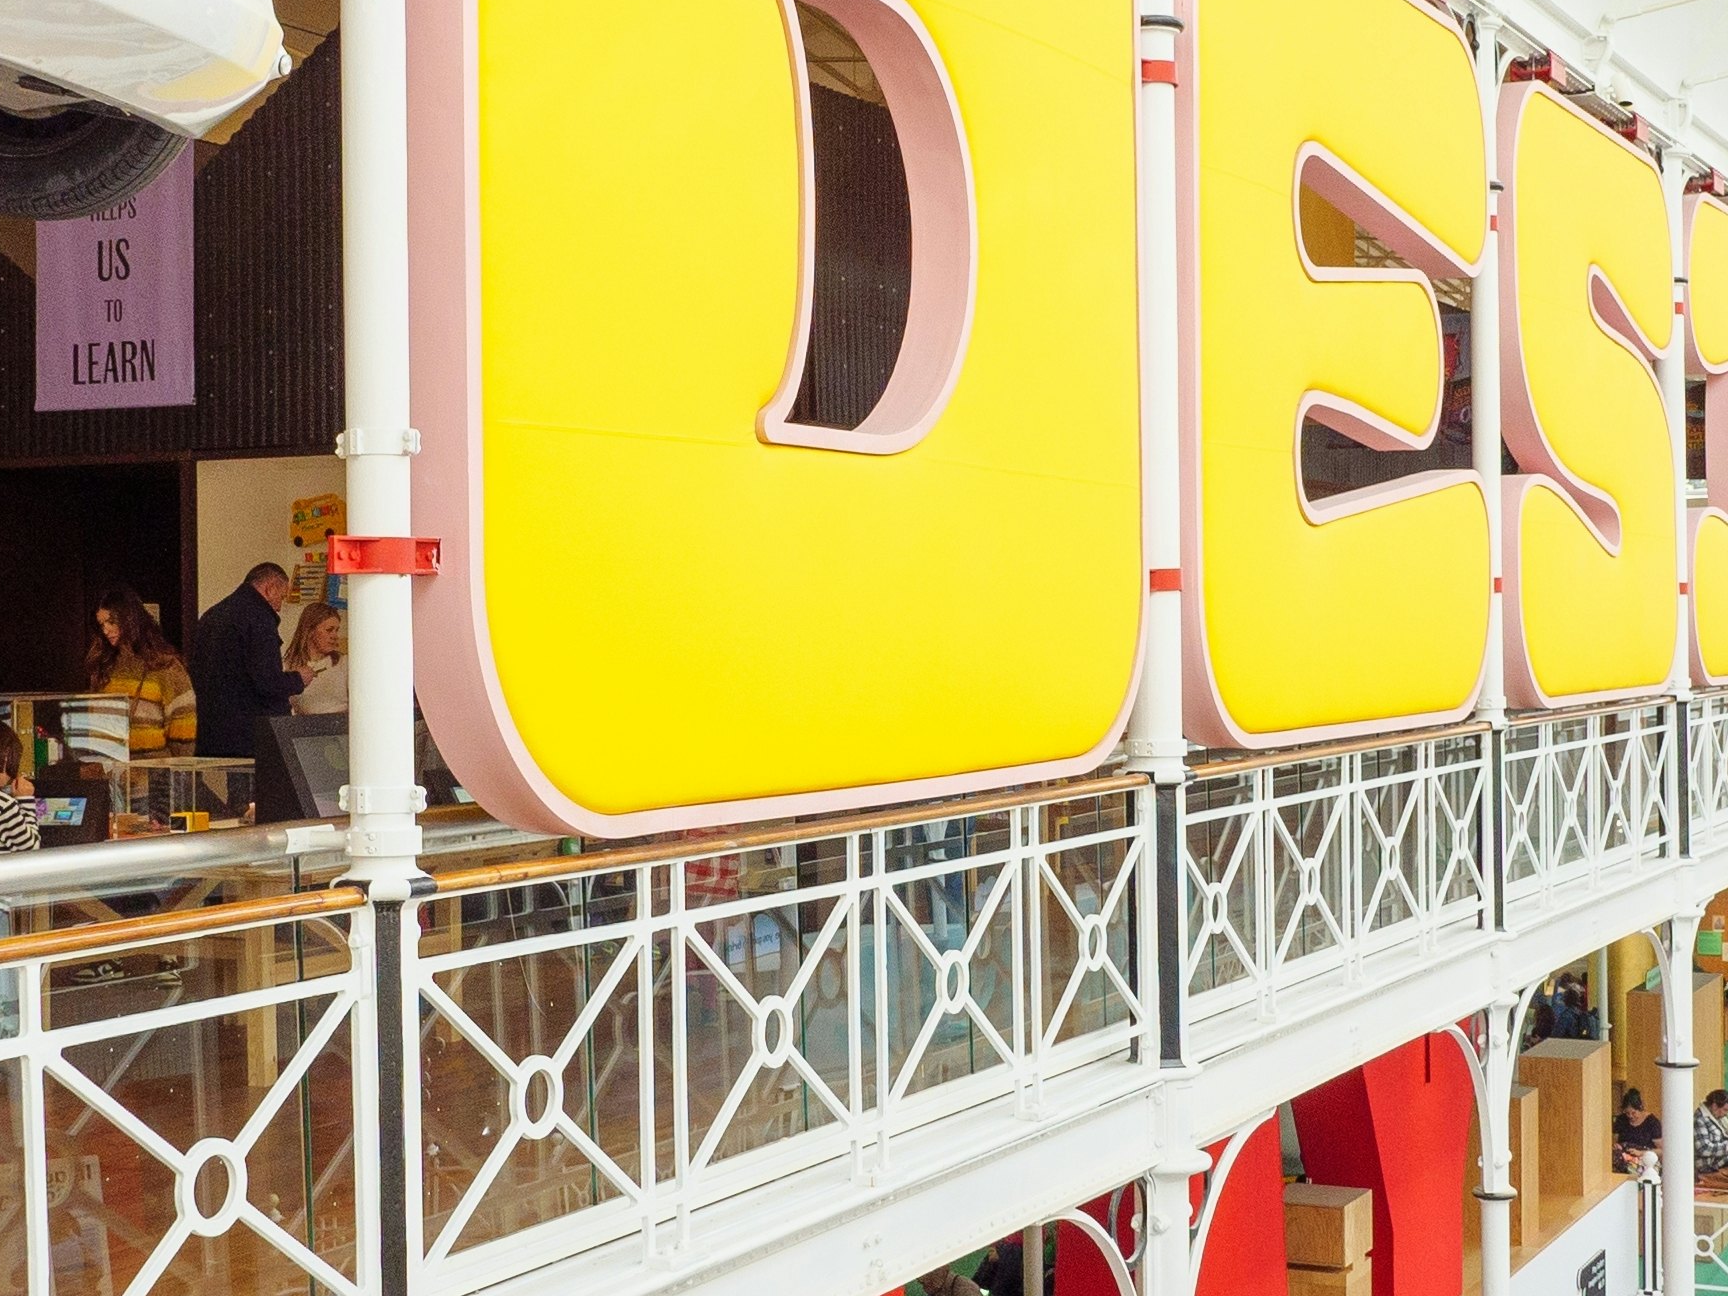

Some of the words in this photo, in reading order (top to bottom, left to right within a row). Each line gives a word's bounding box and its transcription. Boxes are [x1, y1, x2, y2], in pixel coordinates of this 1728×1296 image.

[97, 238, 130, 282] US
[104, 299, 123, 323] TO
[73, 339, 156, 386] LEARN
